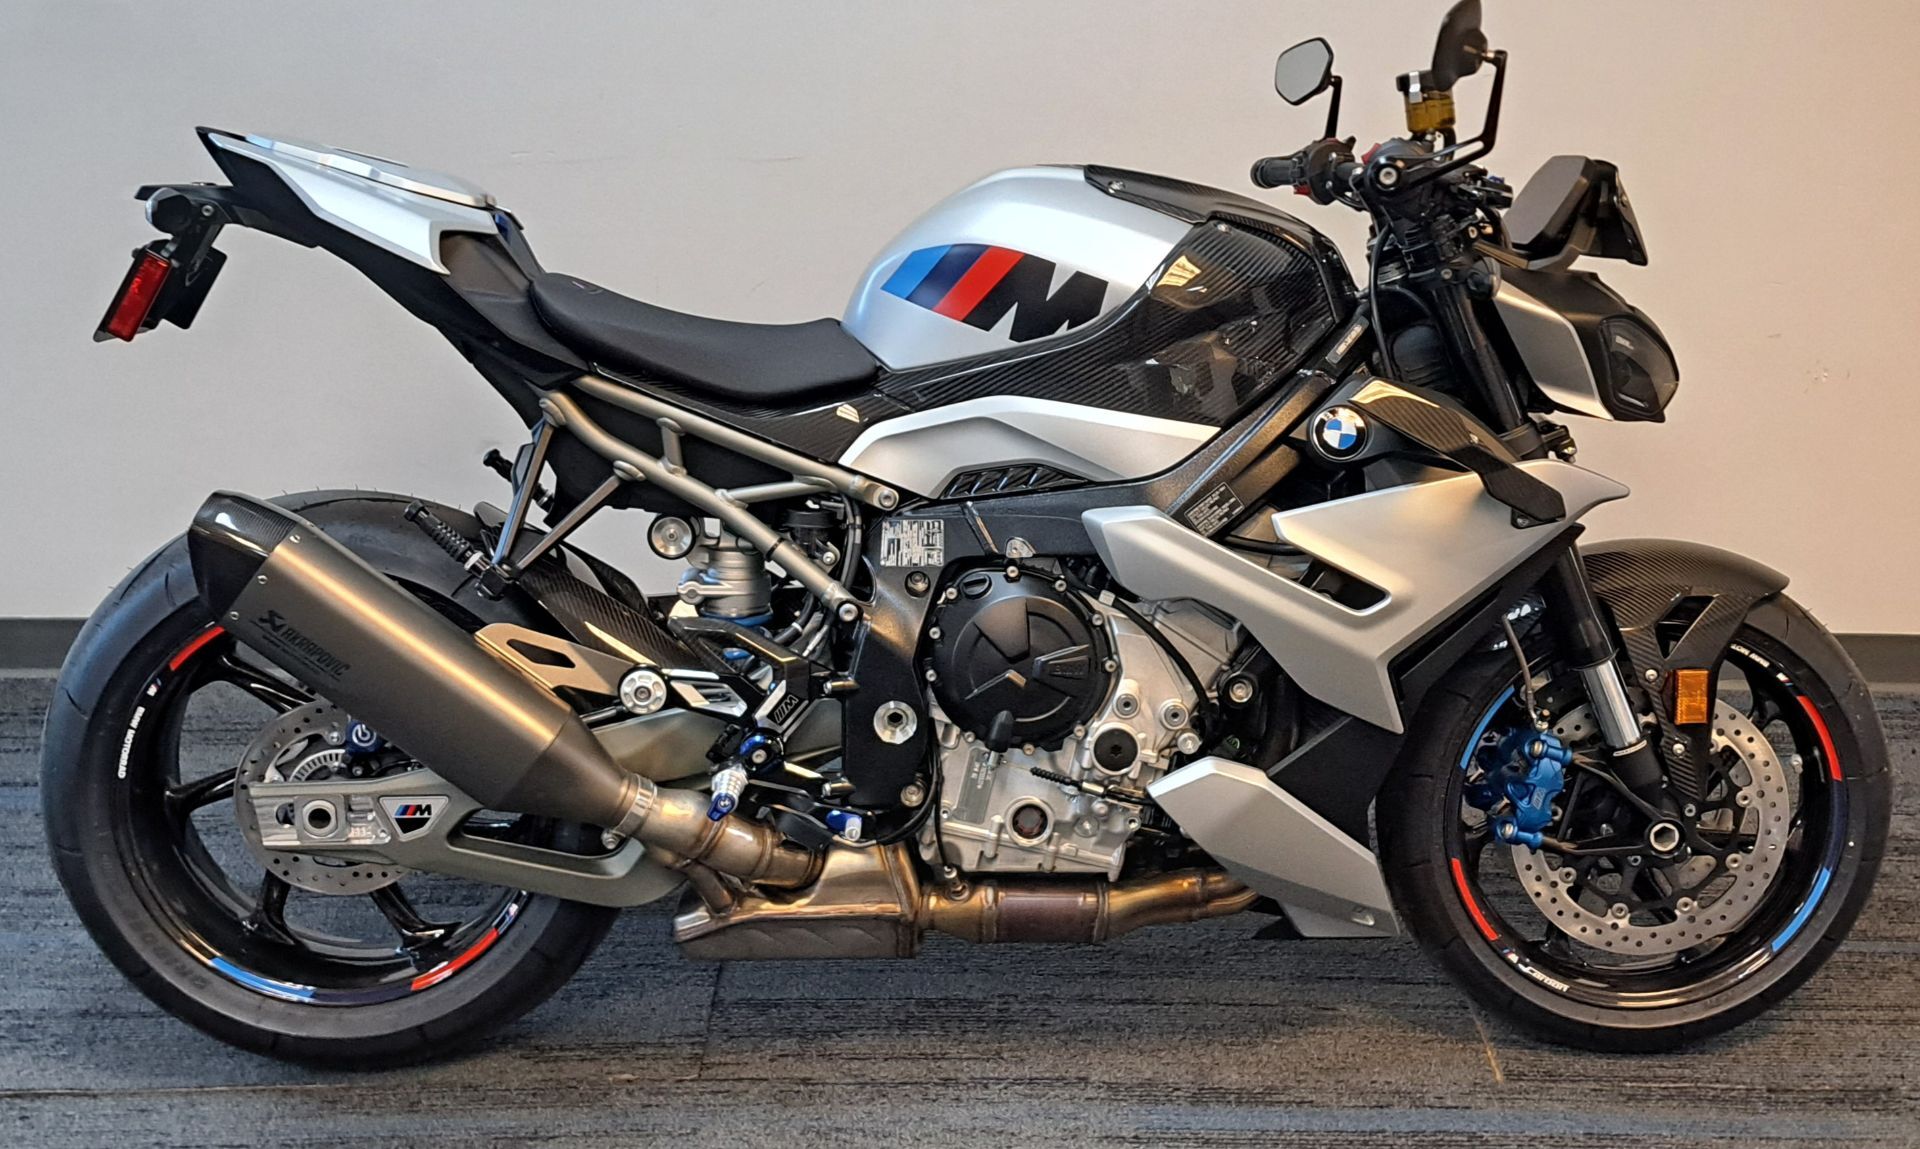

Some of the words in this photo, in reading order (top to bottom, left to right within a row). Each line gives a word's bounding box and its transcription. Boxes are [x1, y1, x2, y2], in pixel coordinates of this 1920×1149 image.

[960, 252, 1109, 343] M
[130, 705, 146, 729] BMW
[117, 728, 136, 779] MOTORRAD
